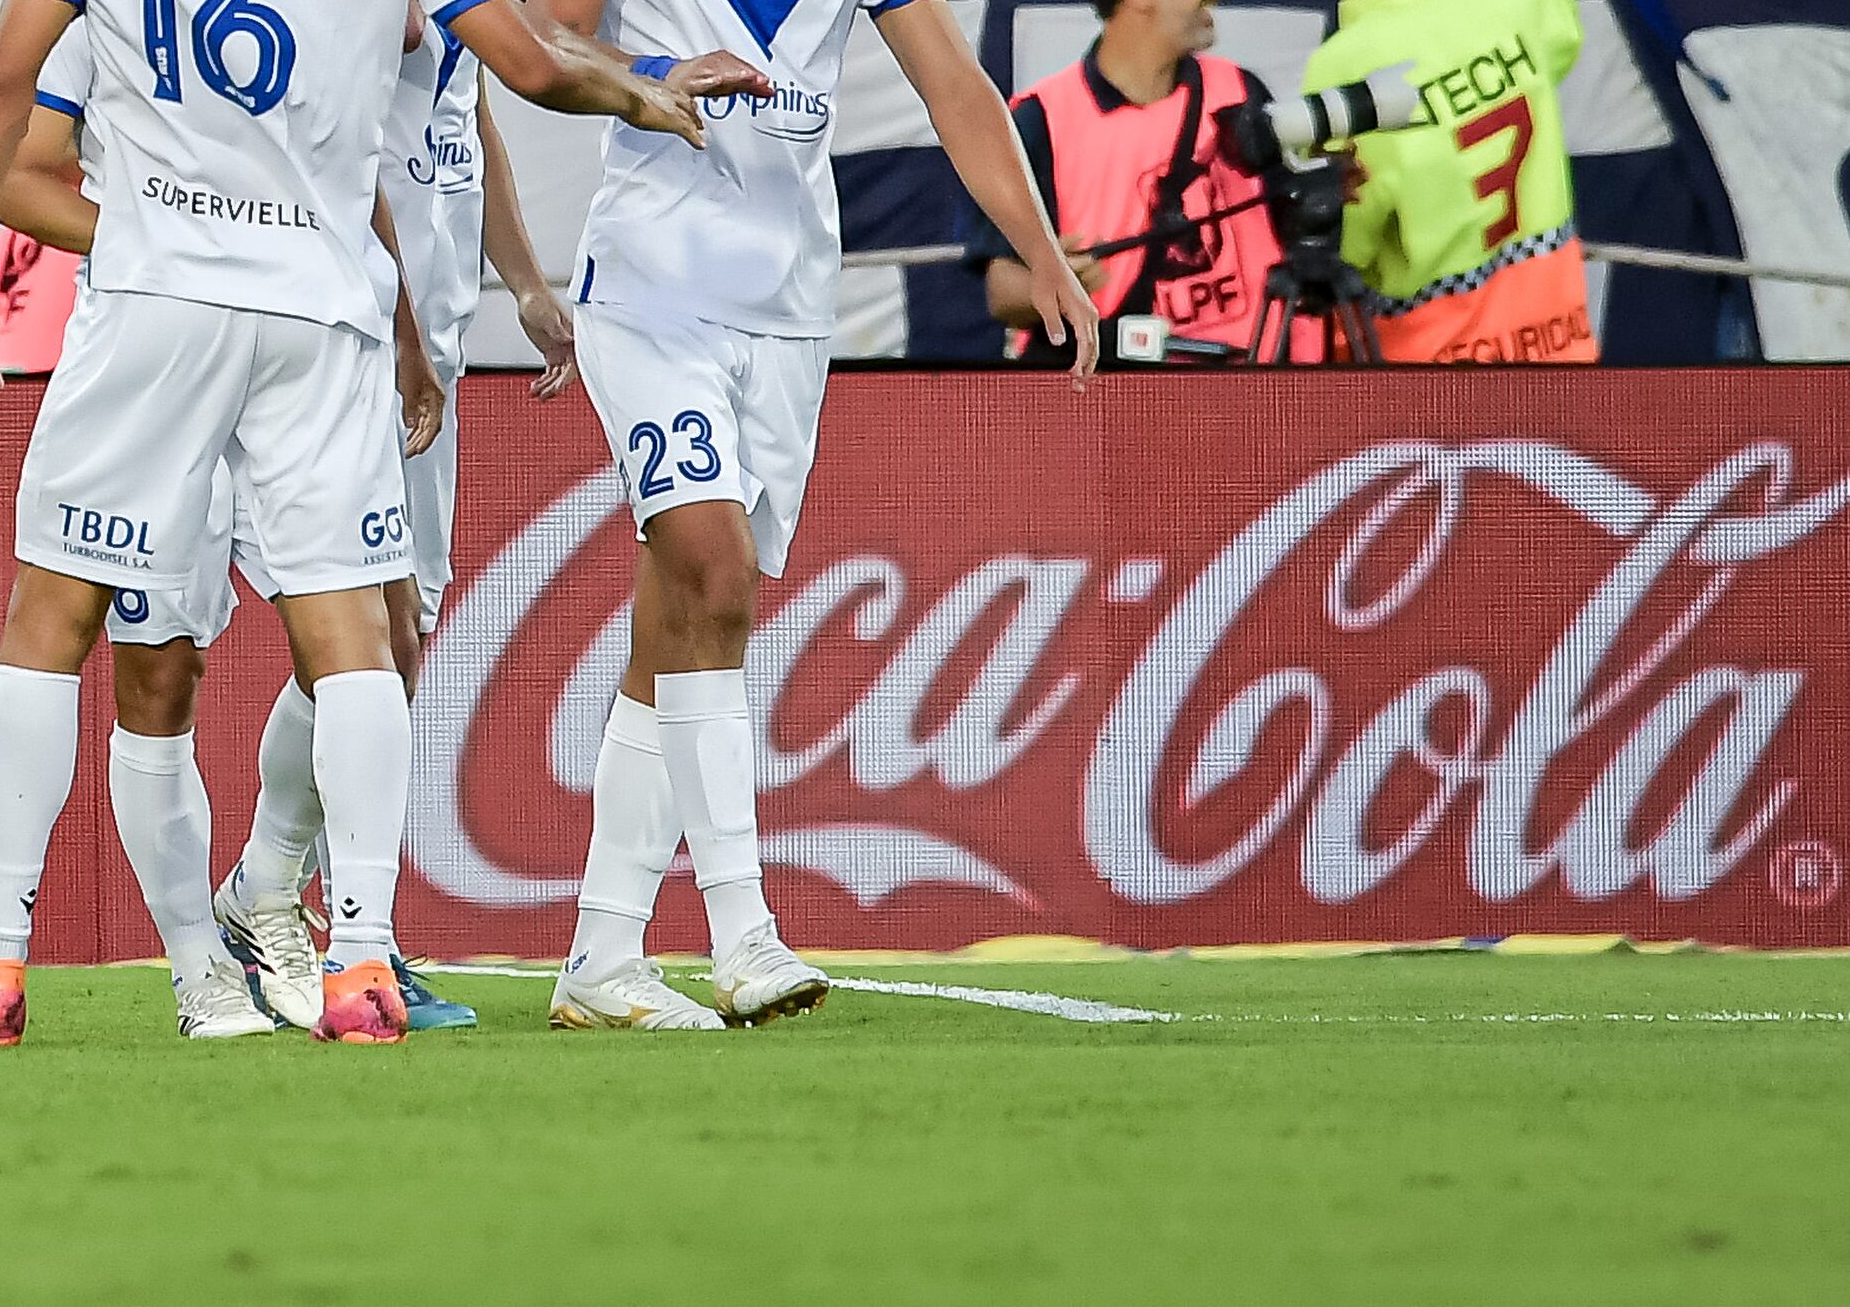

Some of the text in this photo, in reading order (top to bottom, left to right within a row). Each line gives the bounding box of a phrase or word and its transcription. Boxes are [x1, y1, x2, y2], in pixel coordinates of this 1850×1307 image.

[142, 176, 322, 231] SUPERVIELLE
[1163, 274, 1239, 325] LPF
[629, 409, 722, 501] 23
[58, 502, 155, 556] TBDL
